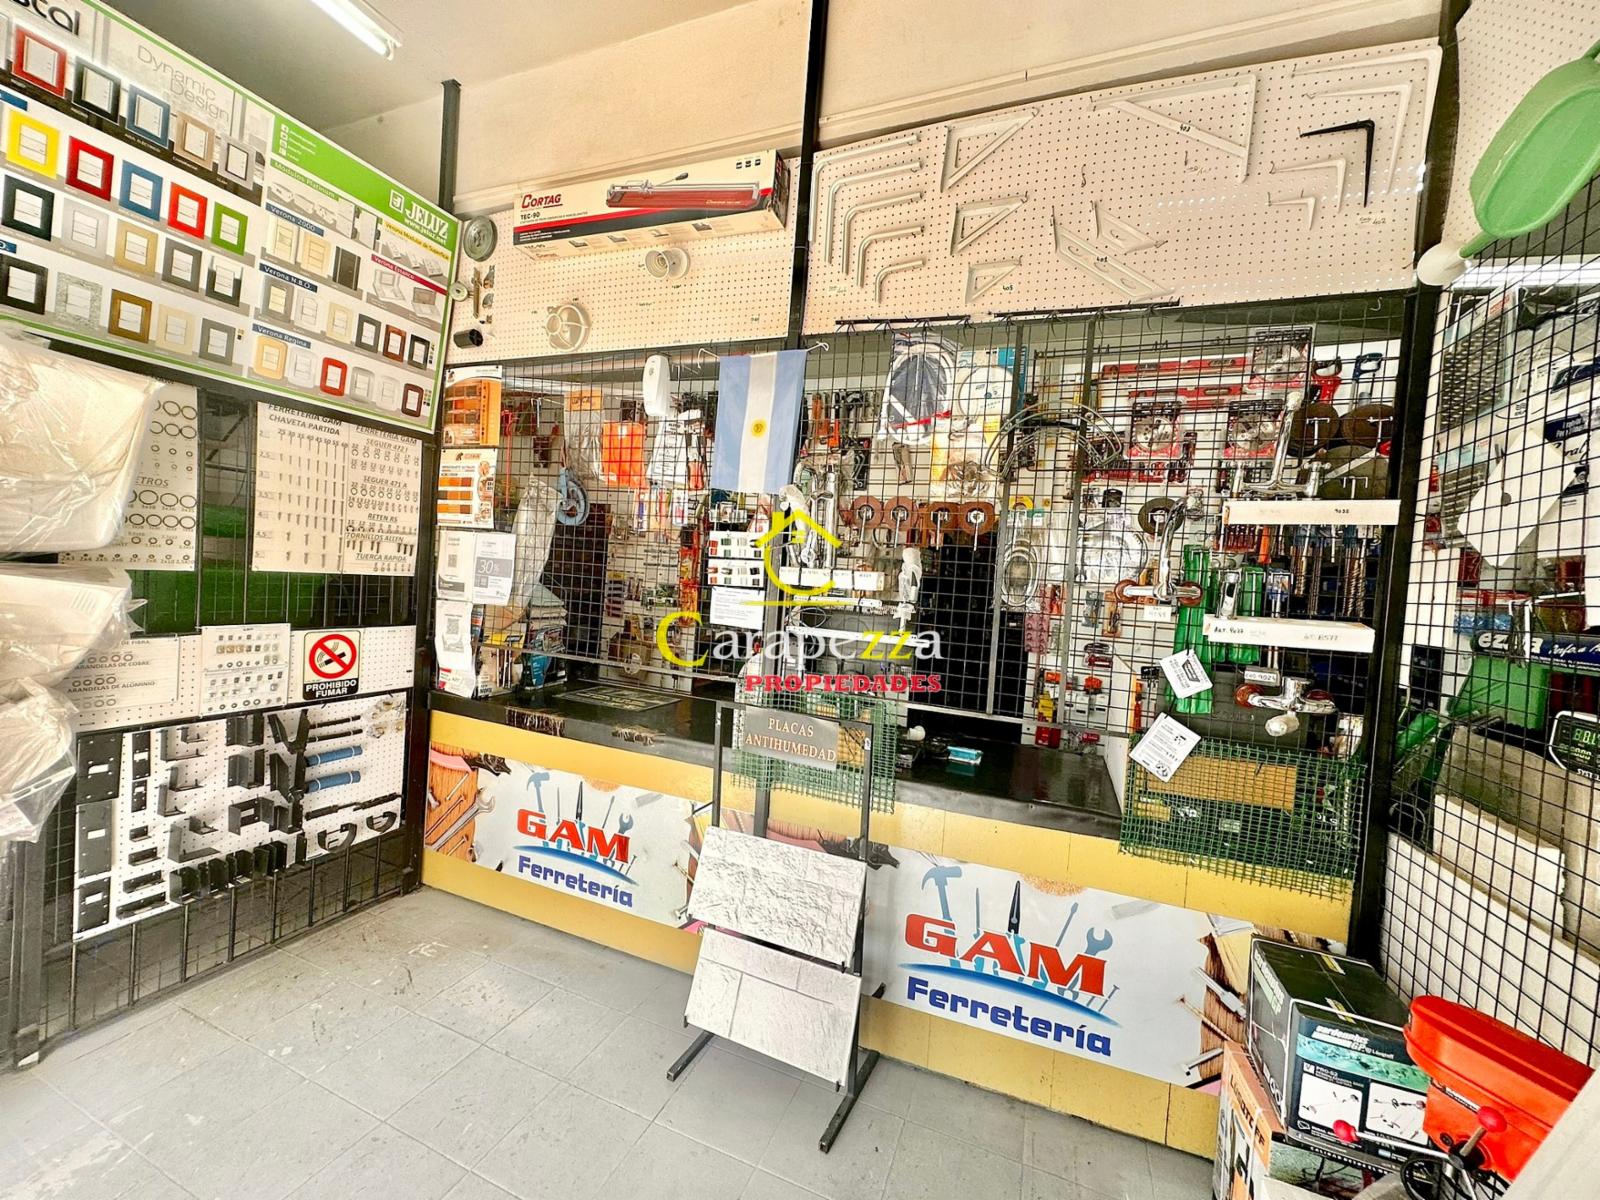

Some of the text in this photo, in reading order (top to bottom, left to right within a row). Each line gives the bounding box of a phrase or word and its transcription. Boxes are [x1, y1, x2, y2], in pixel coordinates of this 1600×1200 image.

[138, 45, 217, 100] Dynamic
[169, 78, 230, 122] Design
[521, 193, 562, 209] CORTAG
[270, 205, 316, 232] Verona 2000
[405, 201, 449, 240] JELUZ
[520, 211, 541, 221] TEC-90
[374, 255, 393, 270] Verona
[264, 266, 289, 282] Verona
[257, 325, 307, 348] Verona Regina
[269, 403, 342, 426] FERRETERIA GAM
[269, 413, 340, 436] CHAVETA PARTIDA
[366, 439, 392, 449] SEGUER
[364, 476, 389, 485] SEGUER
[368, 513, 389, 521] RETEN
[346, 532, 383, 541] TORNILLOS
[74, 662, 117, 670] ARANDELAS
[67, 685, 110, 693] ARANDELAS
[306, 679, 357, 692] PROHIBIDO
[315, 687, 348, 698] FUMAR
[768, 718, 814, 737] PLACAS
[745, 733, 837, 761] ANTIHUMEDAD
[517, 808, 630, 863] GAM
[517, 857, 633, 908] Ferretería
[905, 913, 1109, 996] GAM
[907, 976, 1112, 1057] Ferretería
